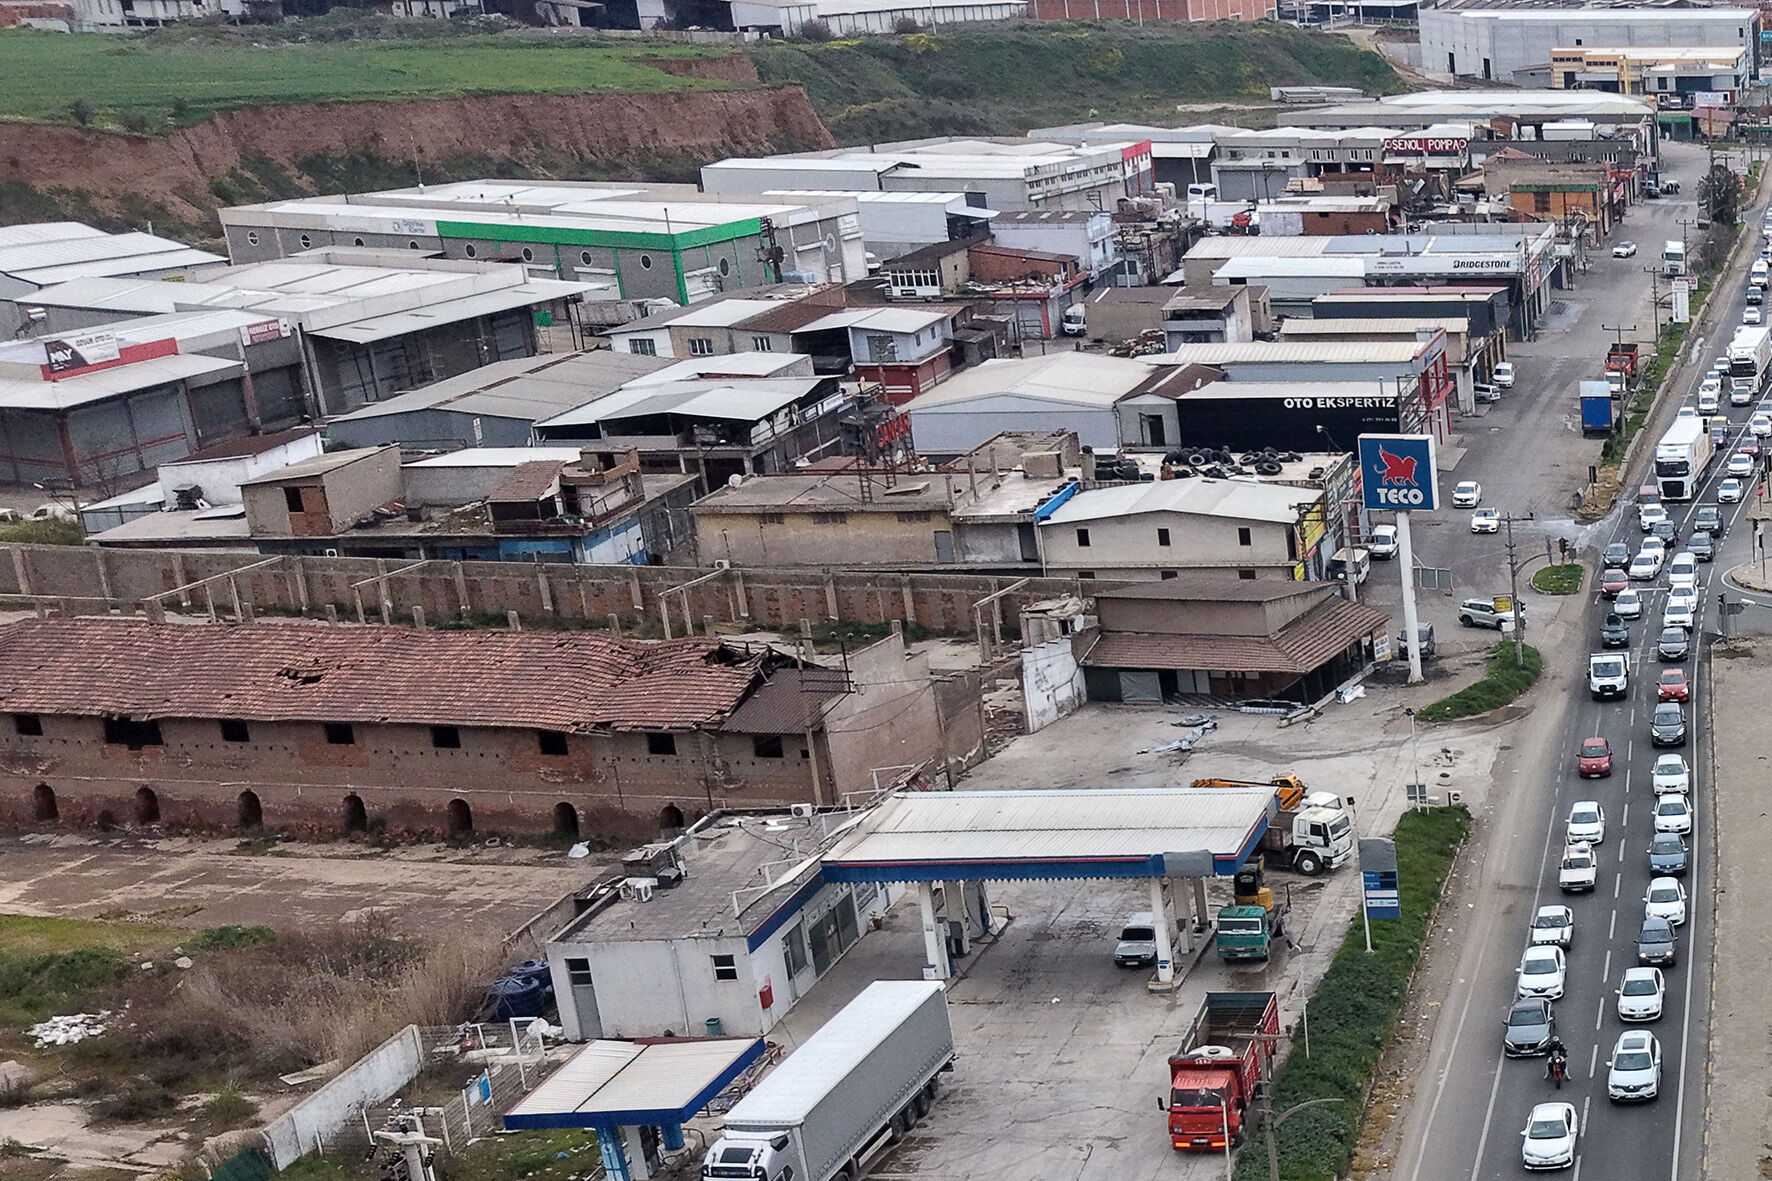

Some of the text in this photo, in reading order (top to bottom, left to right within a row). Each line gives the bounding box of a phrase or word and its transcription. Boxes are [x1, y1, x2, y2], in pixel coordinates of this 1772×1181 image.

[1428, 139, 1460, 151] POMPA
[1453, 260, 1511, 268] BRIDGESTONE
[1283, 396, 1396, 409] OTO EKSPERTİZ
[1377, 488, 1424, 505] TECO
